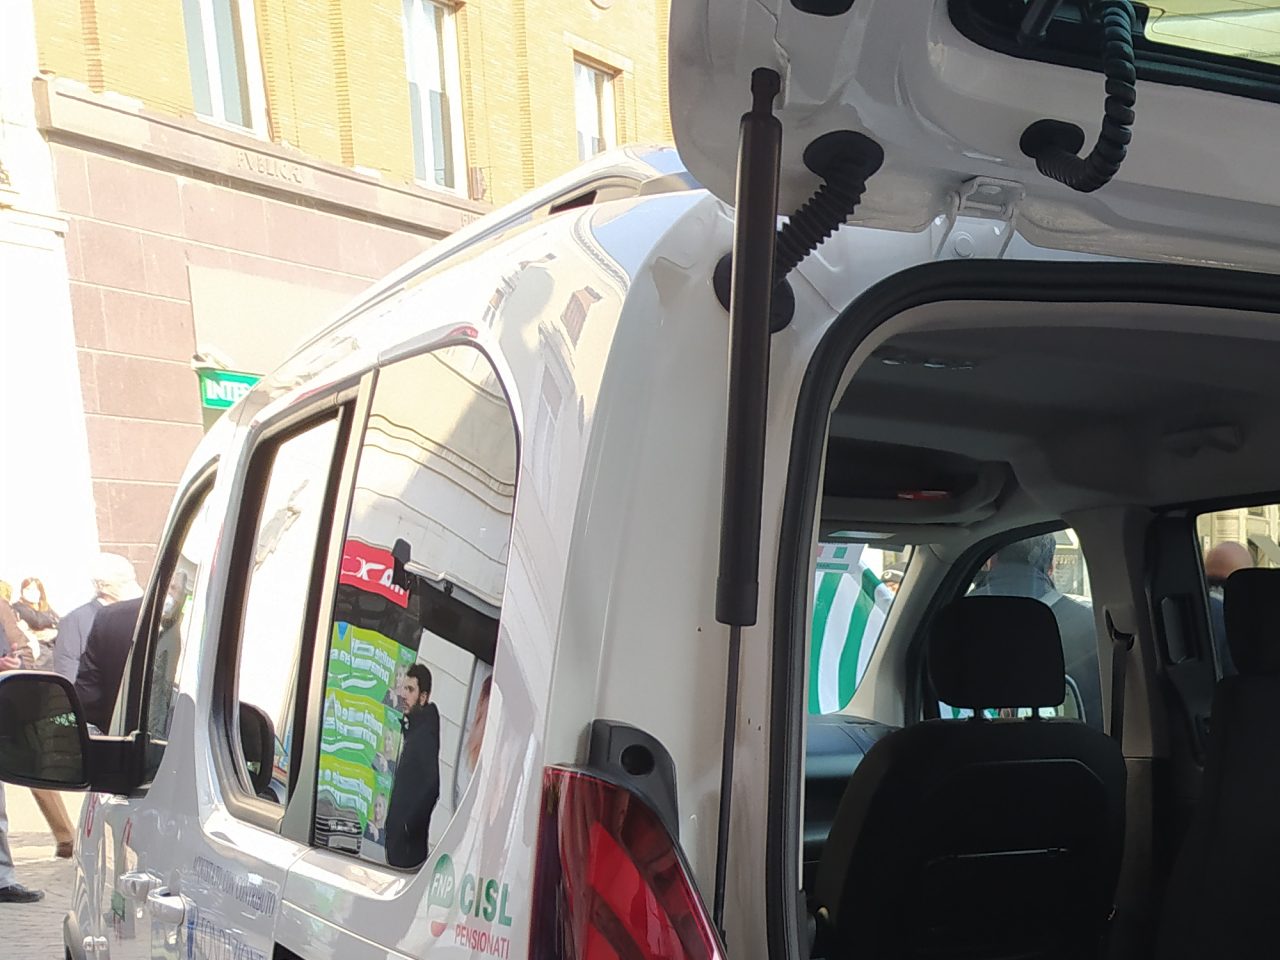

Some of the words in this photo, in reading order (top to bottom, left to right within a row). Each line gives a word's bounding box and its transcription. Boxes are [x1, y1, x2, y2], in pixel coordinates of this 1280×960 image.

[431, 872, 454, 899] FNP
[460, 873, 512, 927] CISL
[454, 923, 510, 960] PENSIONATI
